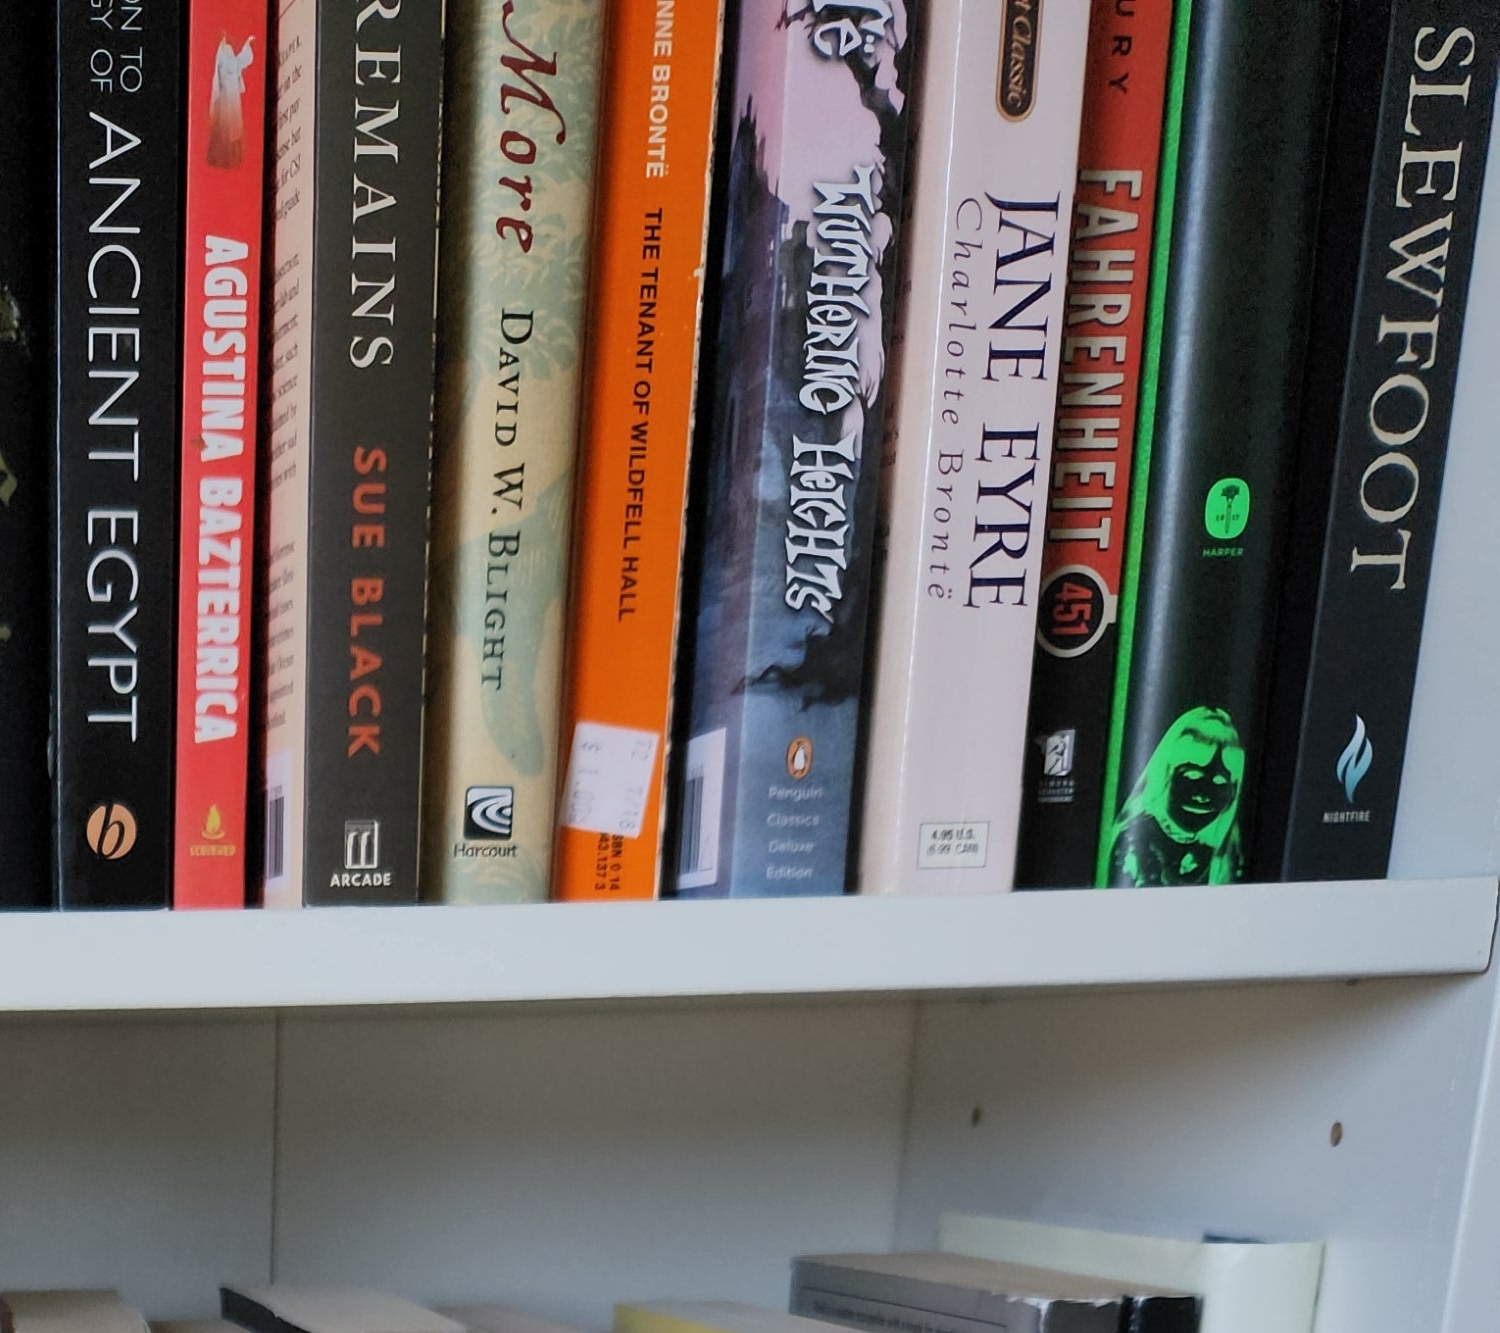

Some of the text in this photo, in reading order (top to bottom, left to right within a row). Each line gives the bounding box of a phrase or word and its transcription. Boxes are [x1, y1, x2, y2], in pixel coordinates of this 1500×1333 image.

[90, 48, 113, 94] OF
[119, 0, 143, 93] N TO
[1007, 15, 1032, 108] Classic
[645, 64, 674, 178] BRONTË
[642, 207, 663, 258] THE
[86, 112, 142, 481] ANCIENT
[638, 263, 661, 377] TENANT
[1349, 25, 1476, 594] SLEWFOOT
[479, 6, 568, 692] More DAVID W. BLIGHT
[633, 380, 655, 415] OF
[926, 197, 982, 602] Charlotte Brontë
[961, 190, 1061, 611] JANE EYRE
[1050, 168, 1143, 636] FAHRENHEIT 451
[193, 235, 251, 745] AGUSTINA BAZTERRICA
[624, 418, 651, 549] WILDFELL
[617, 554, 640, 622] HALL
[1202, 547, 1245, 558] HARPER
[86, 511, 140, 743] EGYPT
[345, 445, 389, 759] SUE BLACK
[765, 812, 821, 828] Classics
[767, 786, 823, 802] Penguin
[1322, 810, 1372, 823] NIGHTFIRE
[329, 872, 393, 888] ARCADE
[453, 842, 519, 860] Harcourt
[611, 834, 624, 858] SBN
[765, 866, 814, 880] Edition
[767, 839, 815, 854] Deluxe
